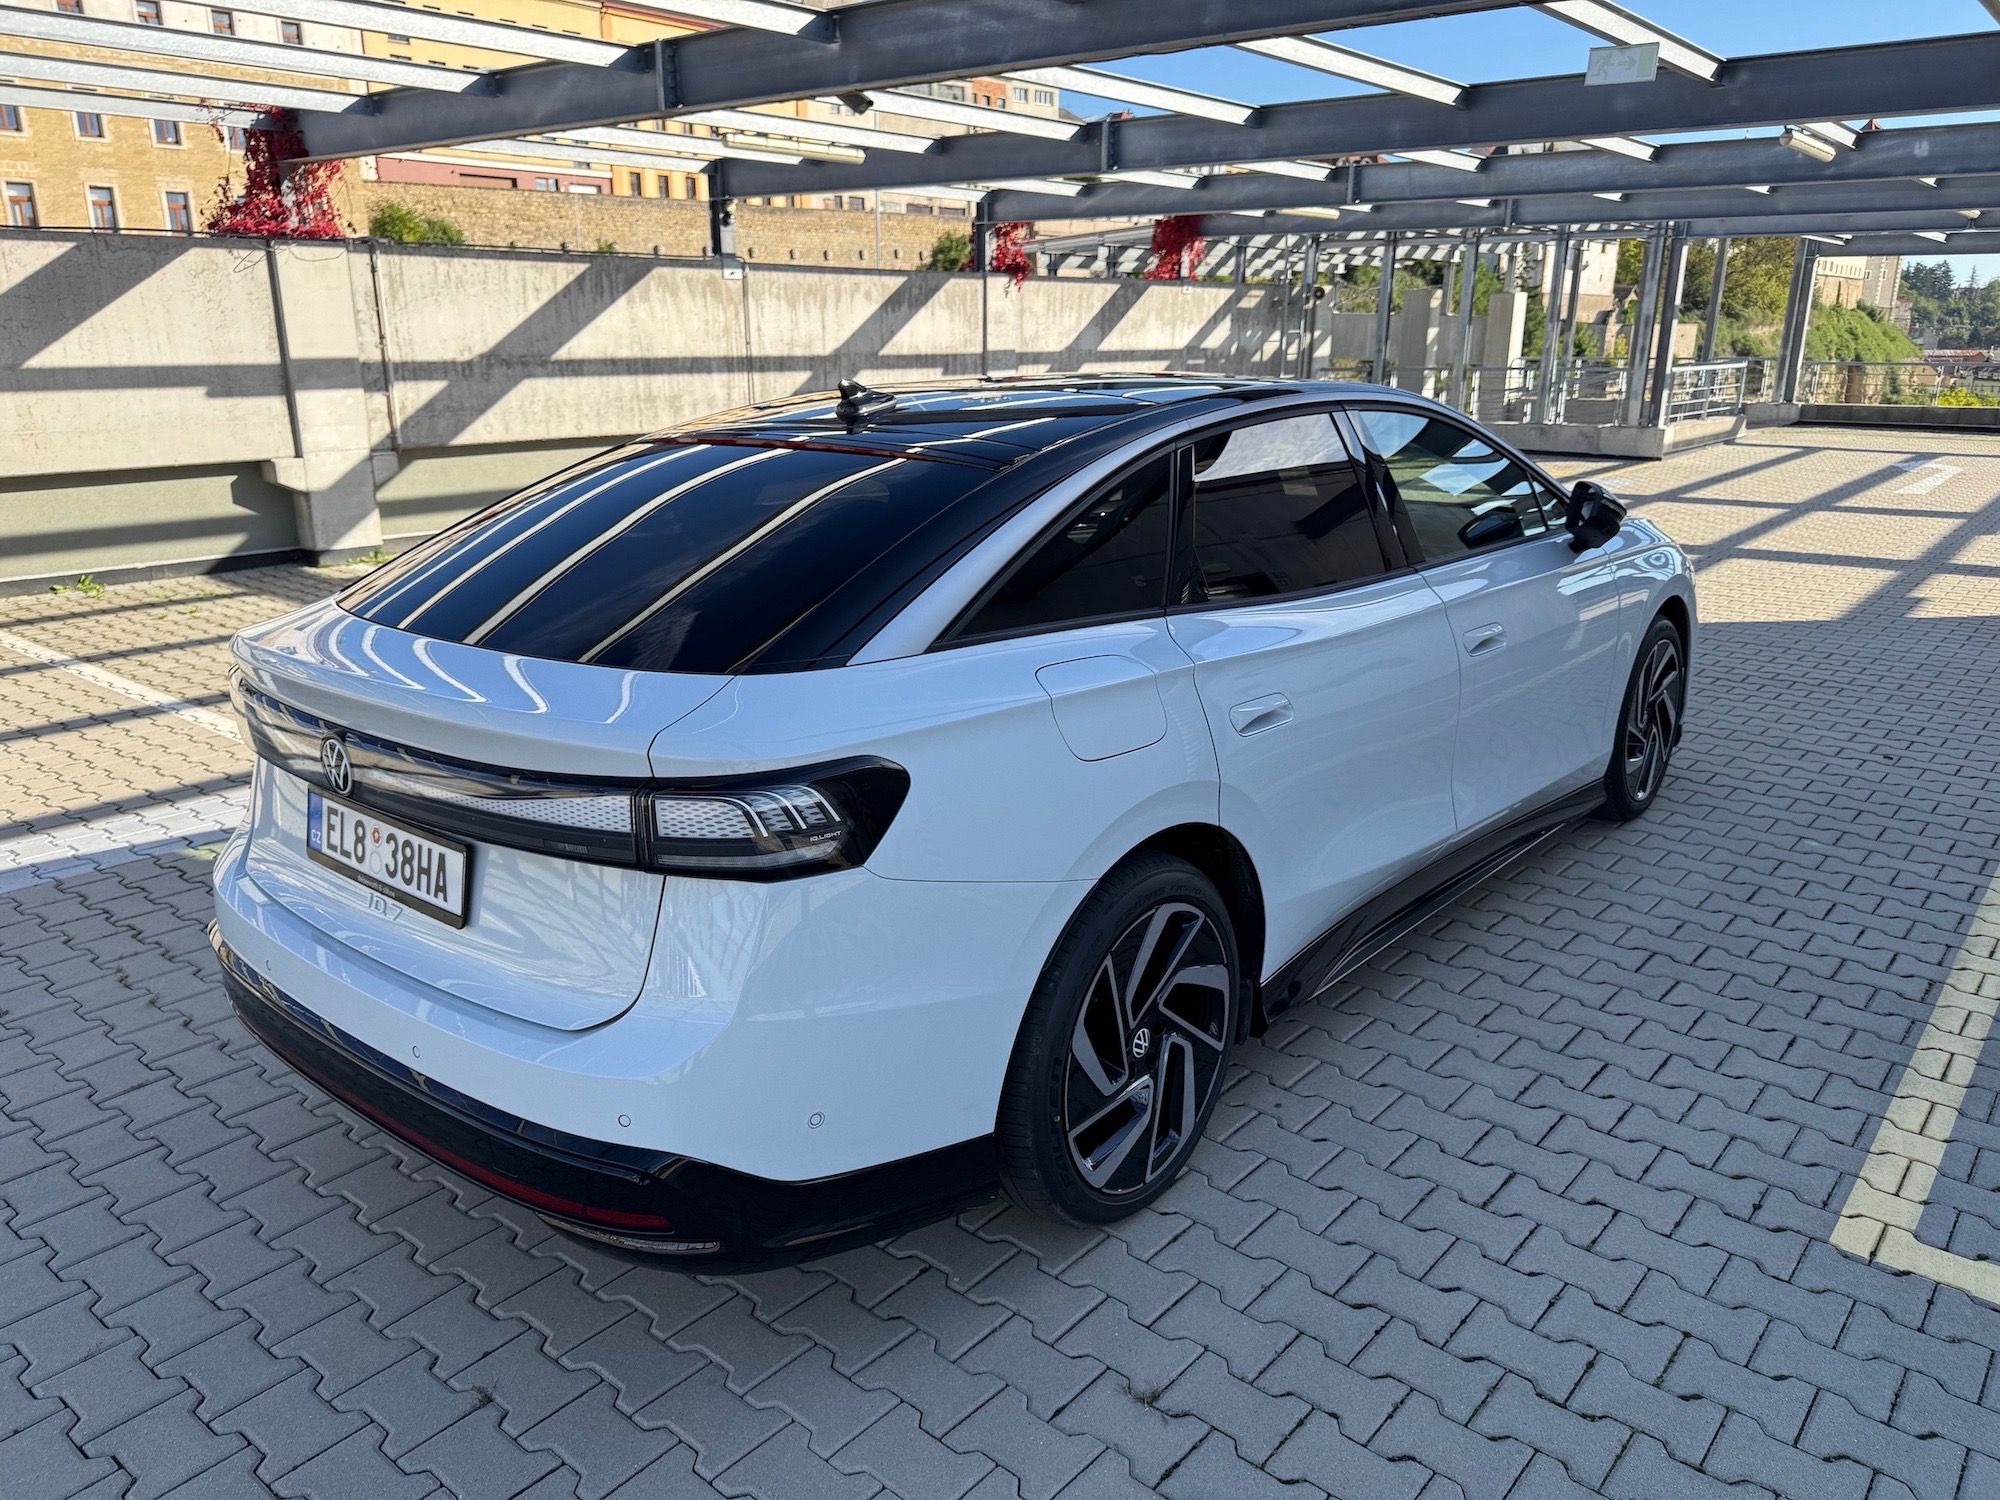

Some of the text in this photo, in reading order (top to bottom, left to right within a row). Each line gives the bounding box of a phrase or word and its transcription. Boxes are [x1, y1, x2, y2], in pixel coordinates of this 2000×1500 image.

[311, 829, 321, 844] CZ
[326, 806, 448, 903] EL8 38HA
[369, 892, 403, 921] ID.7
